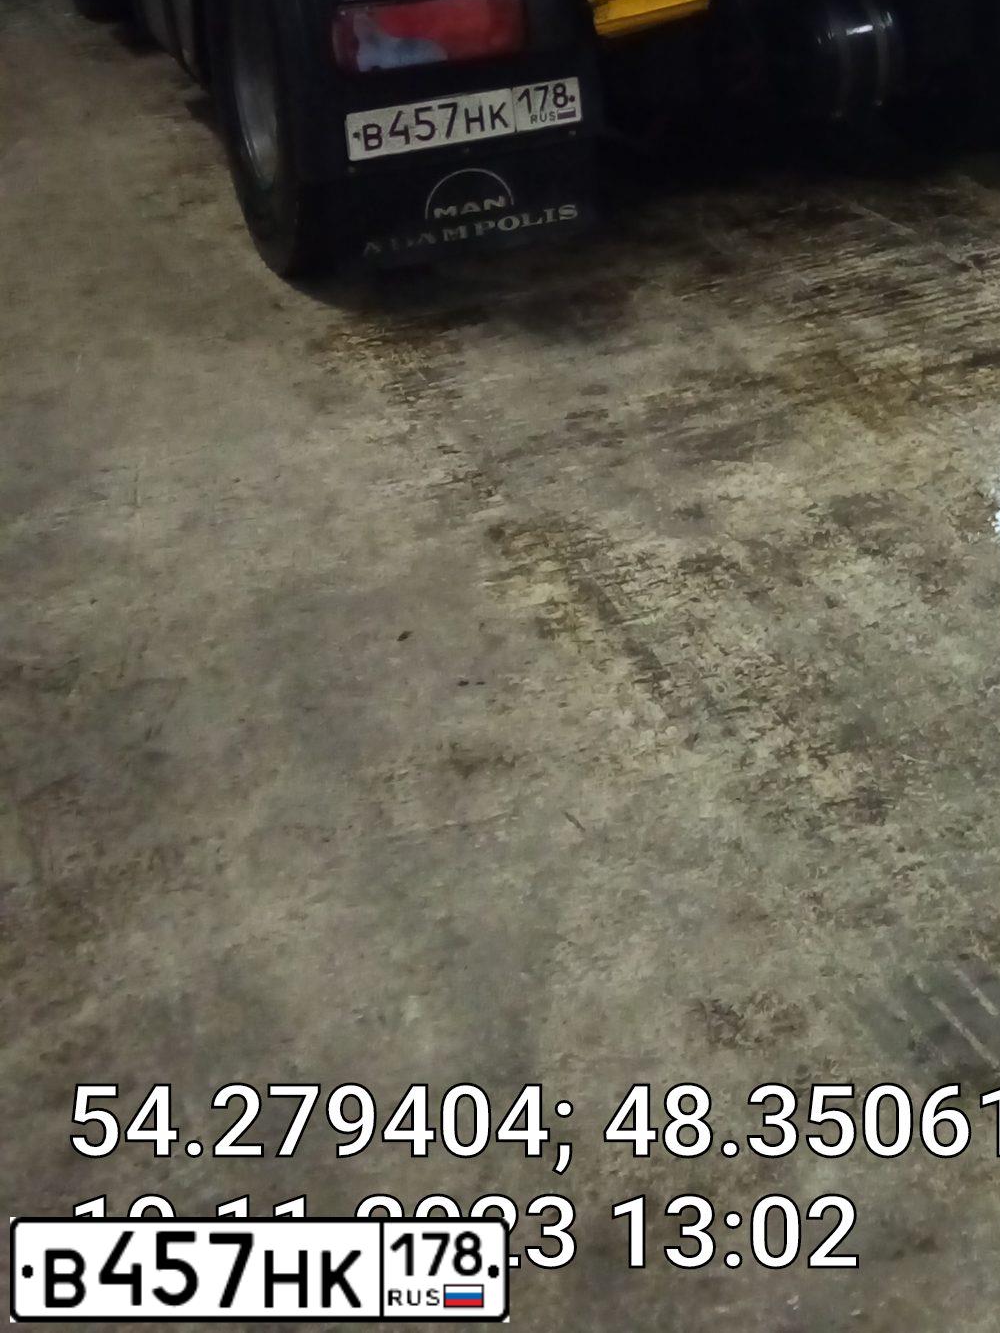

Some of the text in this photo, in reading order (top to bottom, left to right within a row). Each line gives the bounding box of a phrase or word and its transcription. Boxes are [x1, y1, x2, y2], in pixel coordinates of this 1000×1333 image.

[517, 82, 567, 112] 178
[529, 110, 557, 126] RUS
[433, 195, 505, 218] MAN
